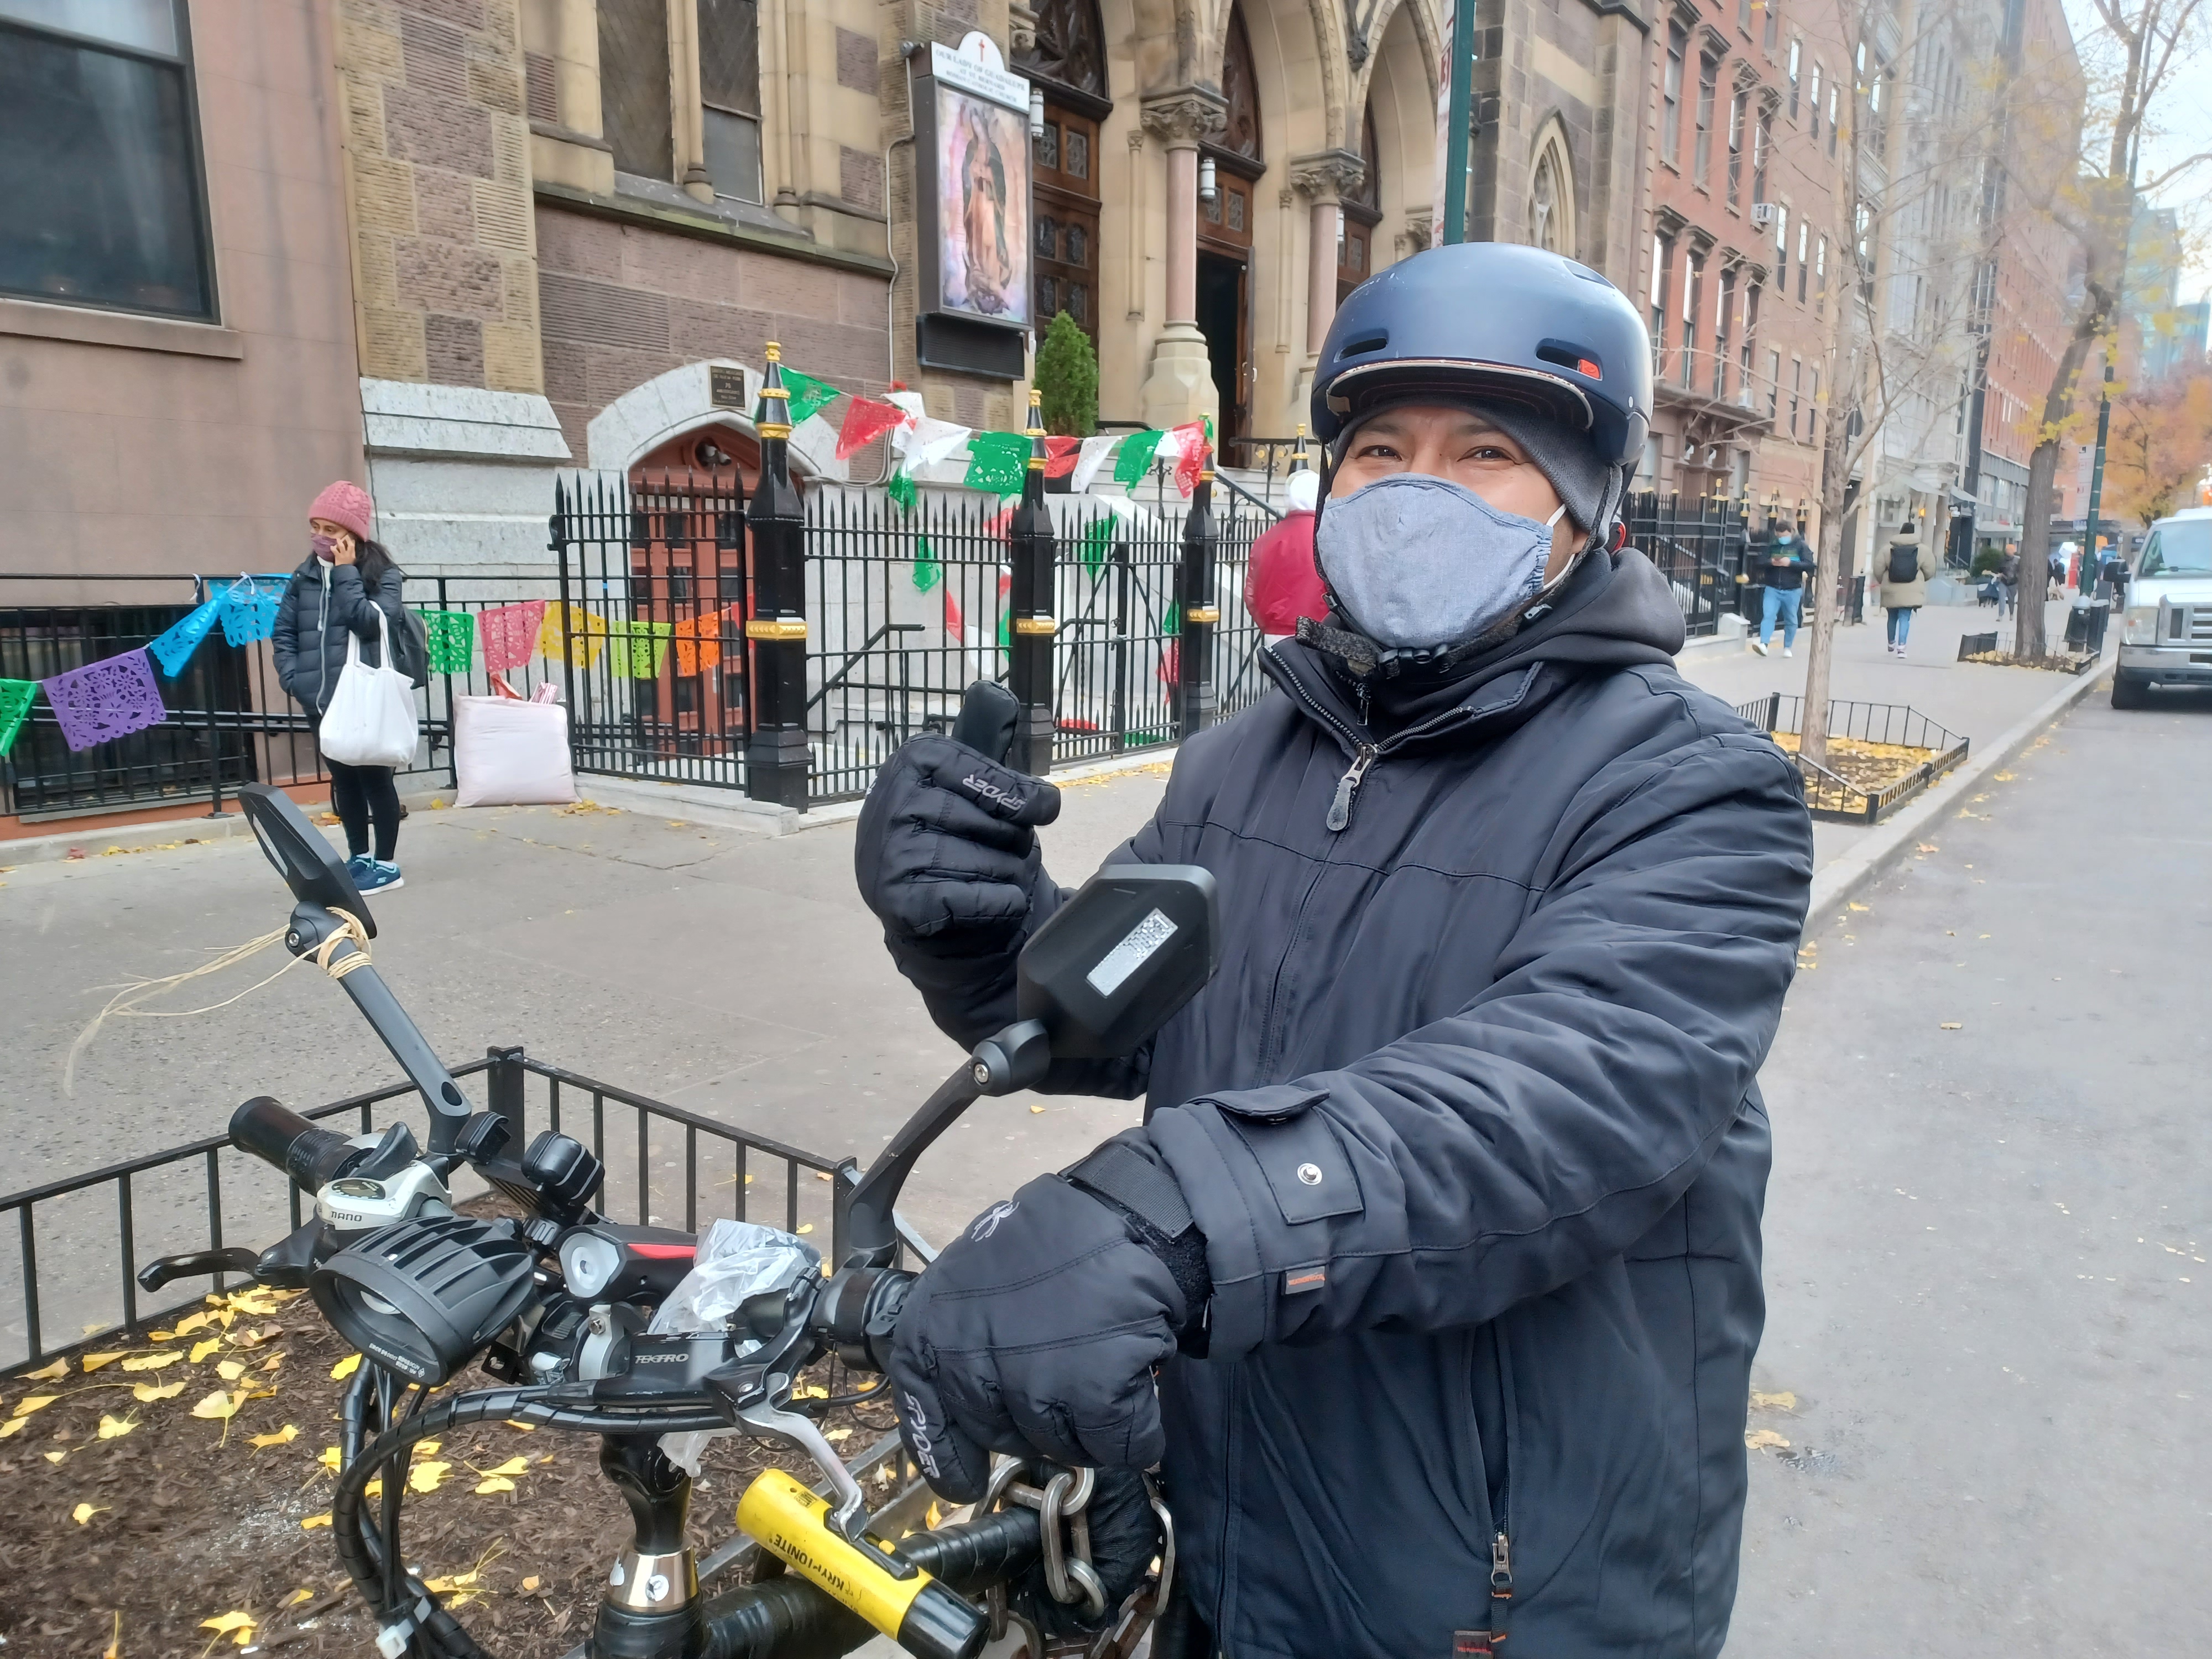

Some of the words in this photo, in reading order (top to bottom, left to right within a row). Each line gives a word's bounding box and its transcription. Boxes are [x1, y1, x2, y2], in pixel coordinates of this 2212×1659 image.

[963, 774, 1027, 811] SPYDER
[635, 1353, 689, 1364] TEKTRO
[904, 1391, 940, 1479] SPYDER
